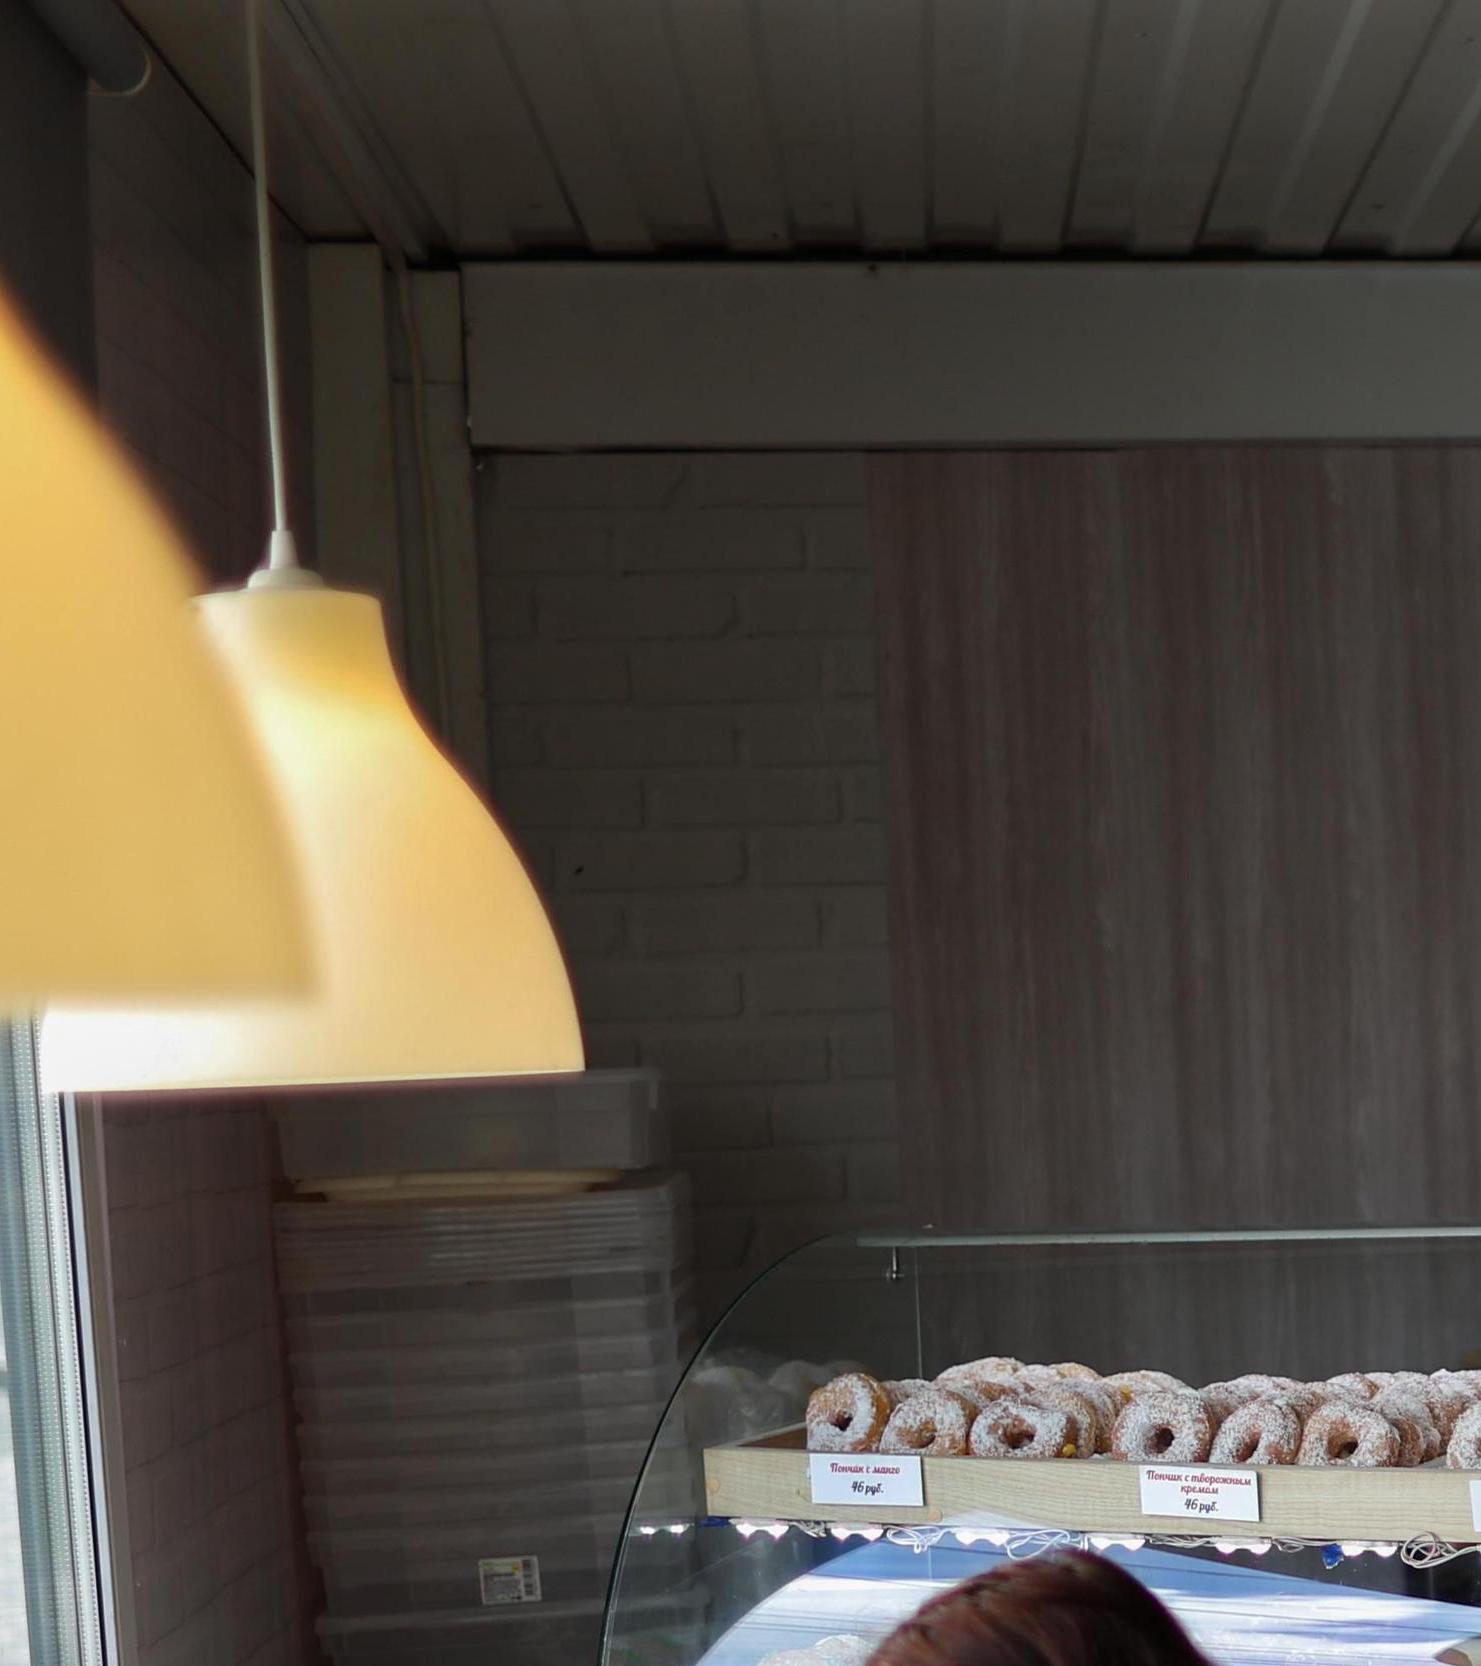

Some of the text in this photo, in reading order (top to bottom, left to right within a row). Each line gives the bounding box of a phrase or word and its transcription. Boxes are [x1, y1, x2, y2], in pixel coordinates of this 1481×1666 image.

[830, 1463, 864, 1474] Пончик
[872, 1465, 900, 1475] манго
[1146, 1470, 1252, 1486] Пончик с творожным
[852, 1481, 885, 1496] 46 руб.
[1180, 1484, 1219, 1495] кремом
[1184, 1498, 1219, 1514] 46 руб.
